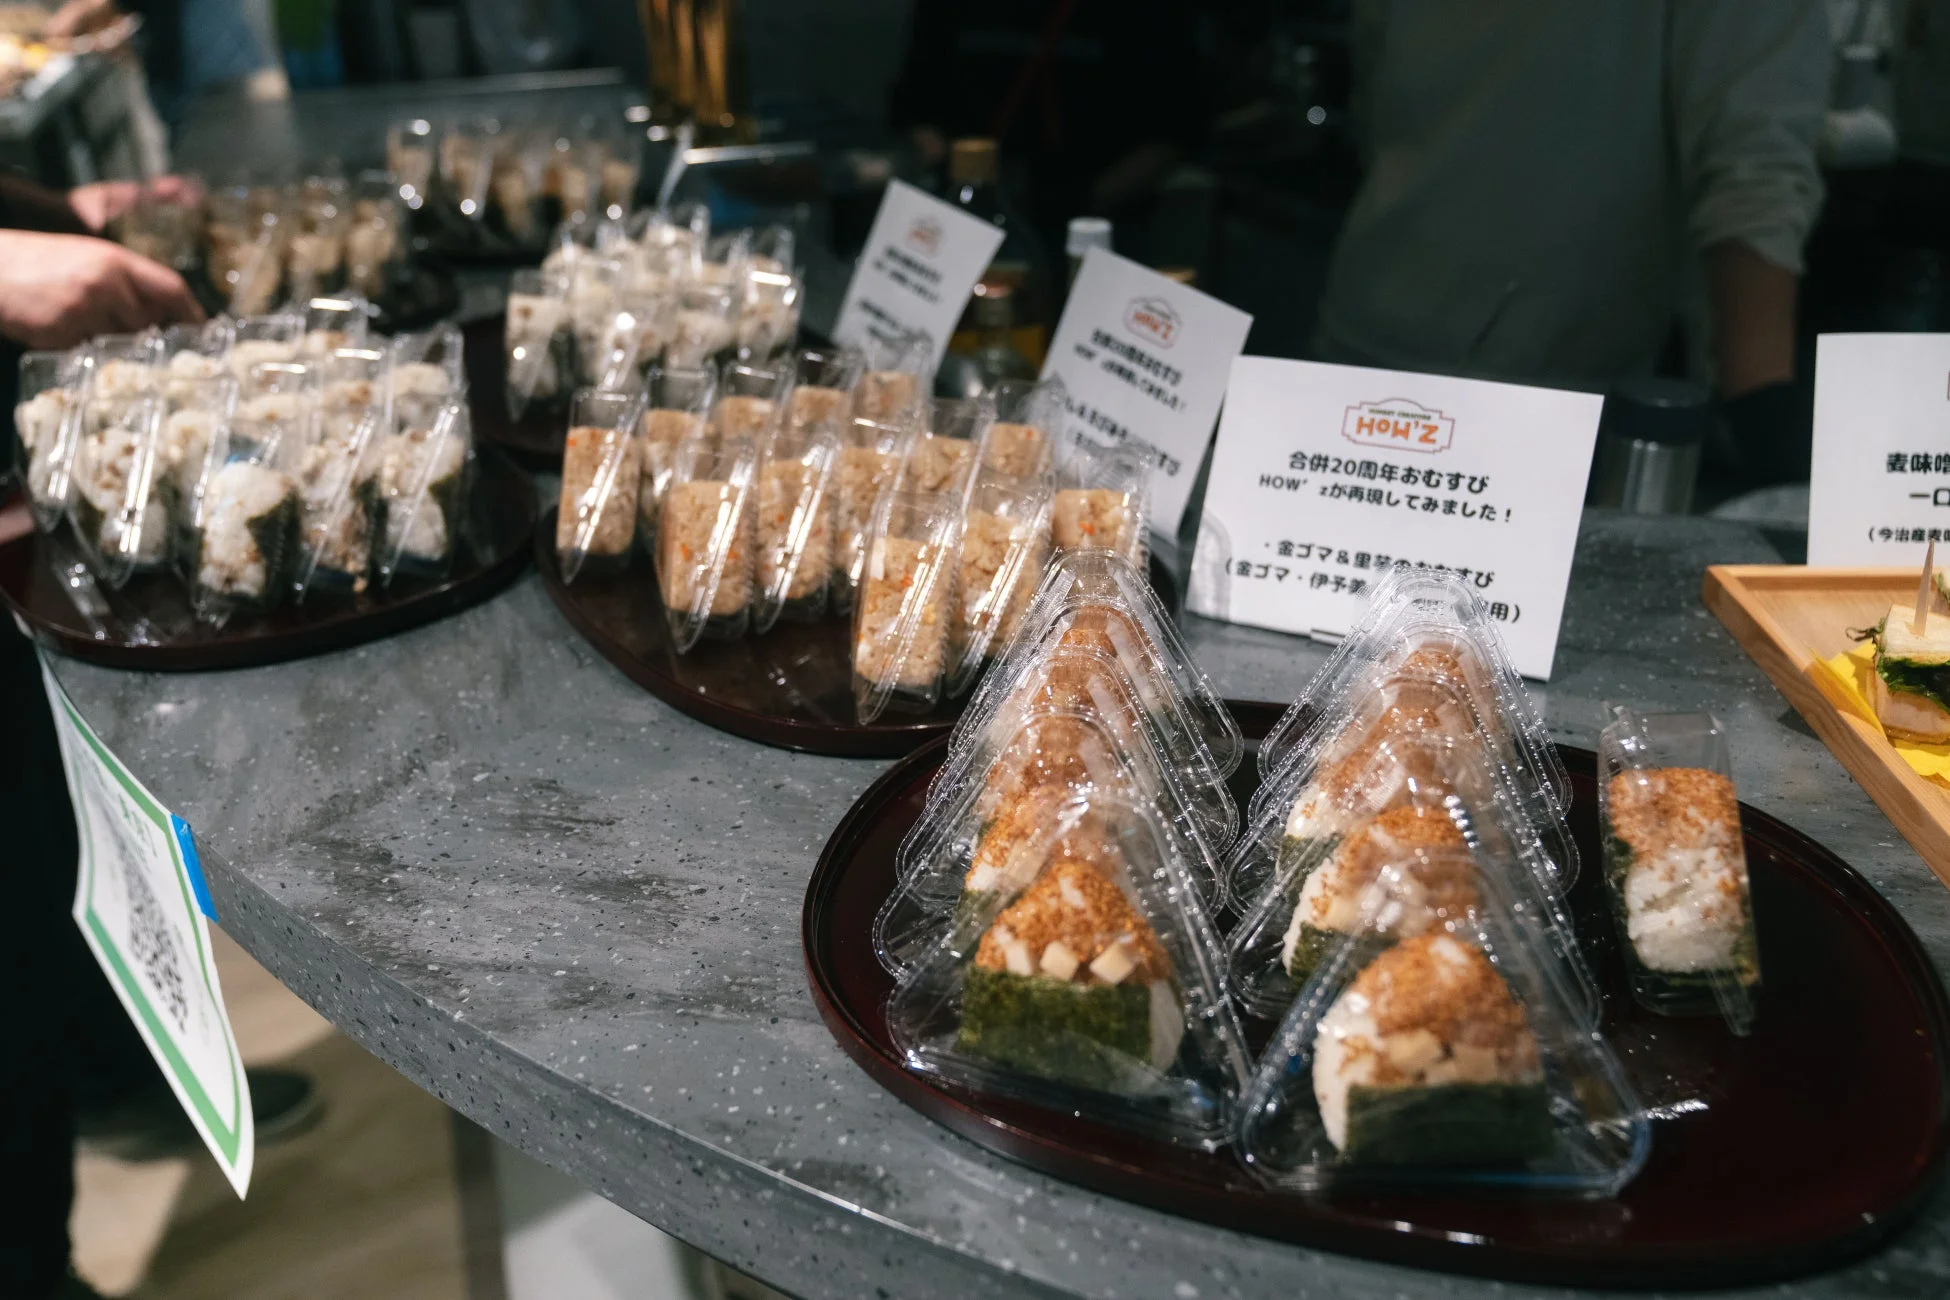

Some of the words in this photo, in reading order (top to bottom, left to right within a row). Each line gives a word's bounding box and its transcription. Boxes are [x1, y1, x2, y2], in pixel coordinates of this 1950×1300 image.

[1356, 416, 1439, 444] HOW'Z
[1289, 451, 1490, 494] 合併20周年おむすび
